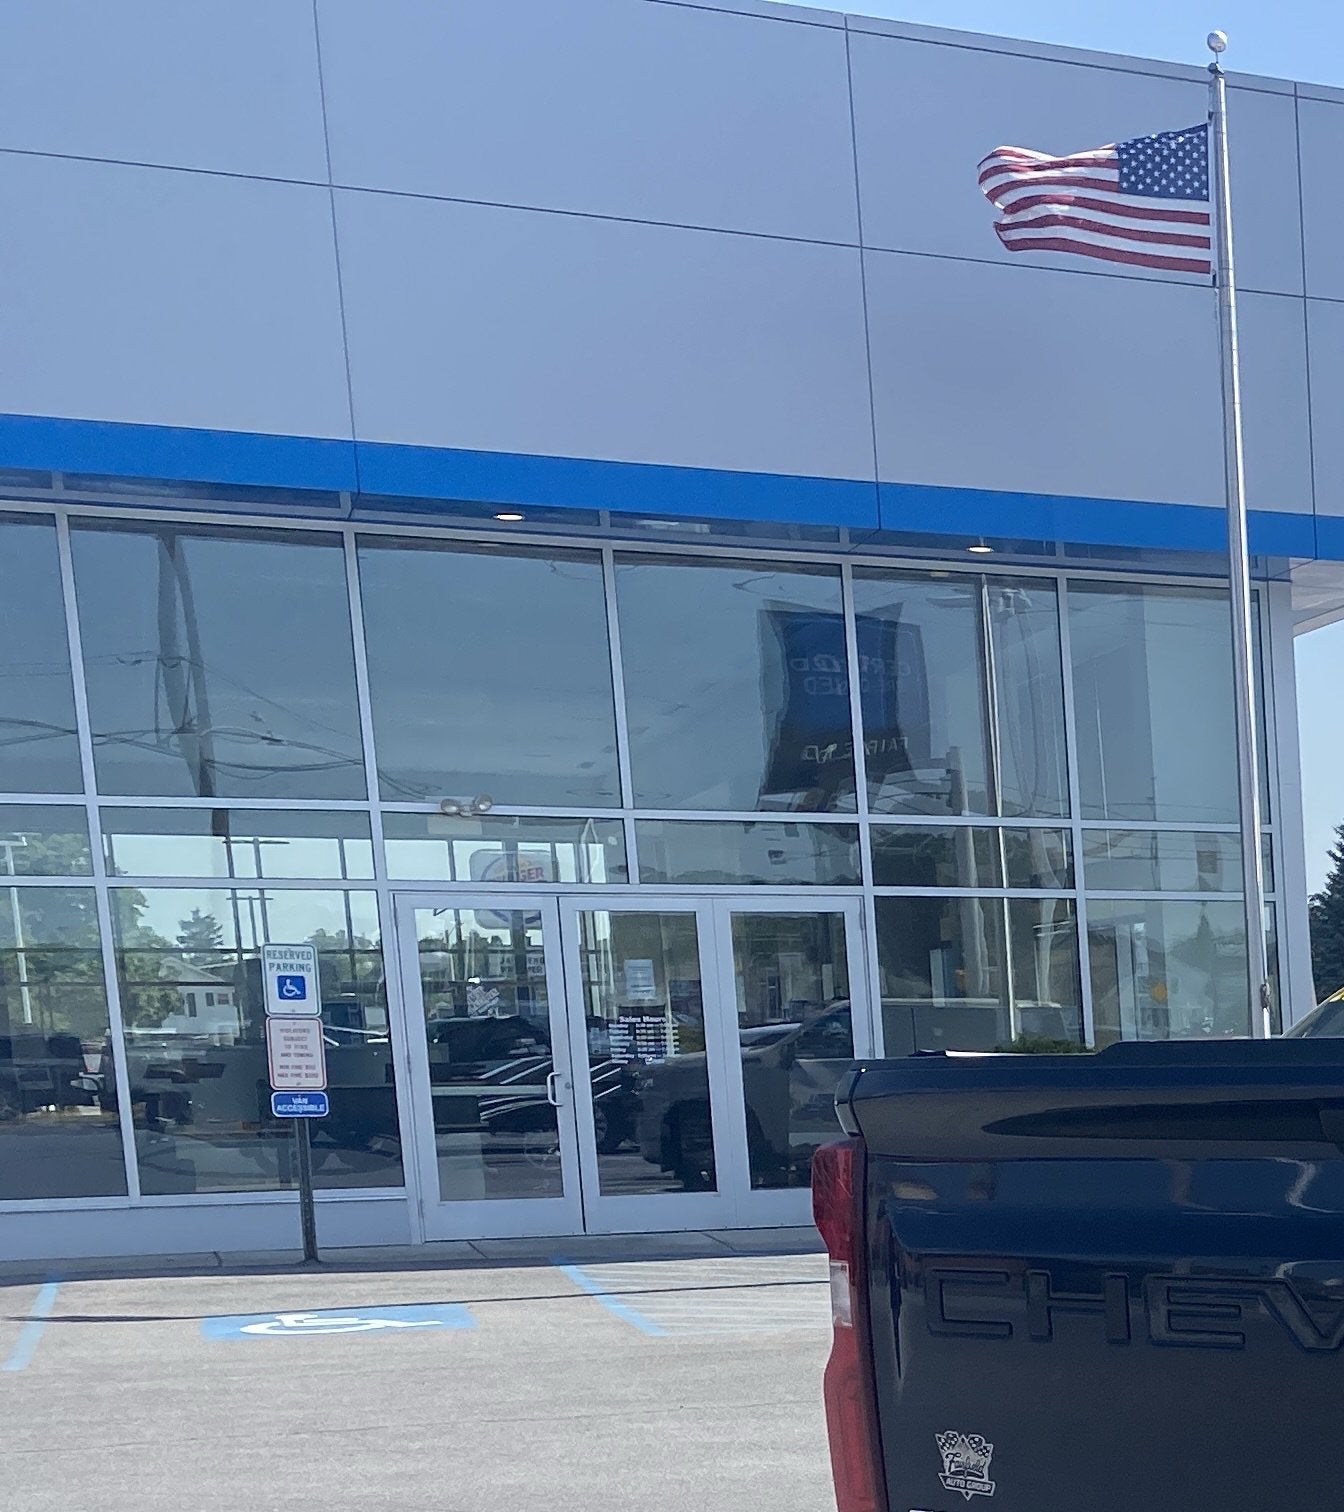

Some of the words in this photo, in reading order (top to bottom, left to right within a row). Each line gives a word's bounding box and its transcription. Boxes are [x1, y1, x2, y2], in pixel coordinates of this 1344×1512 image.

[265, 949, 313, 961] RESERVED
[268, 962, 312, 973] PARKING
[291, 1097, 309, 1105] VAN
[276, 1103, 326, 1113] ACCESSIBLE
[945, 1477, 966, 1488] AUTO
[966, 1480, 992, 1492] GROUP
